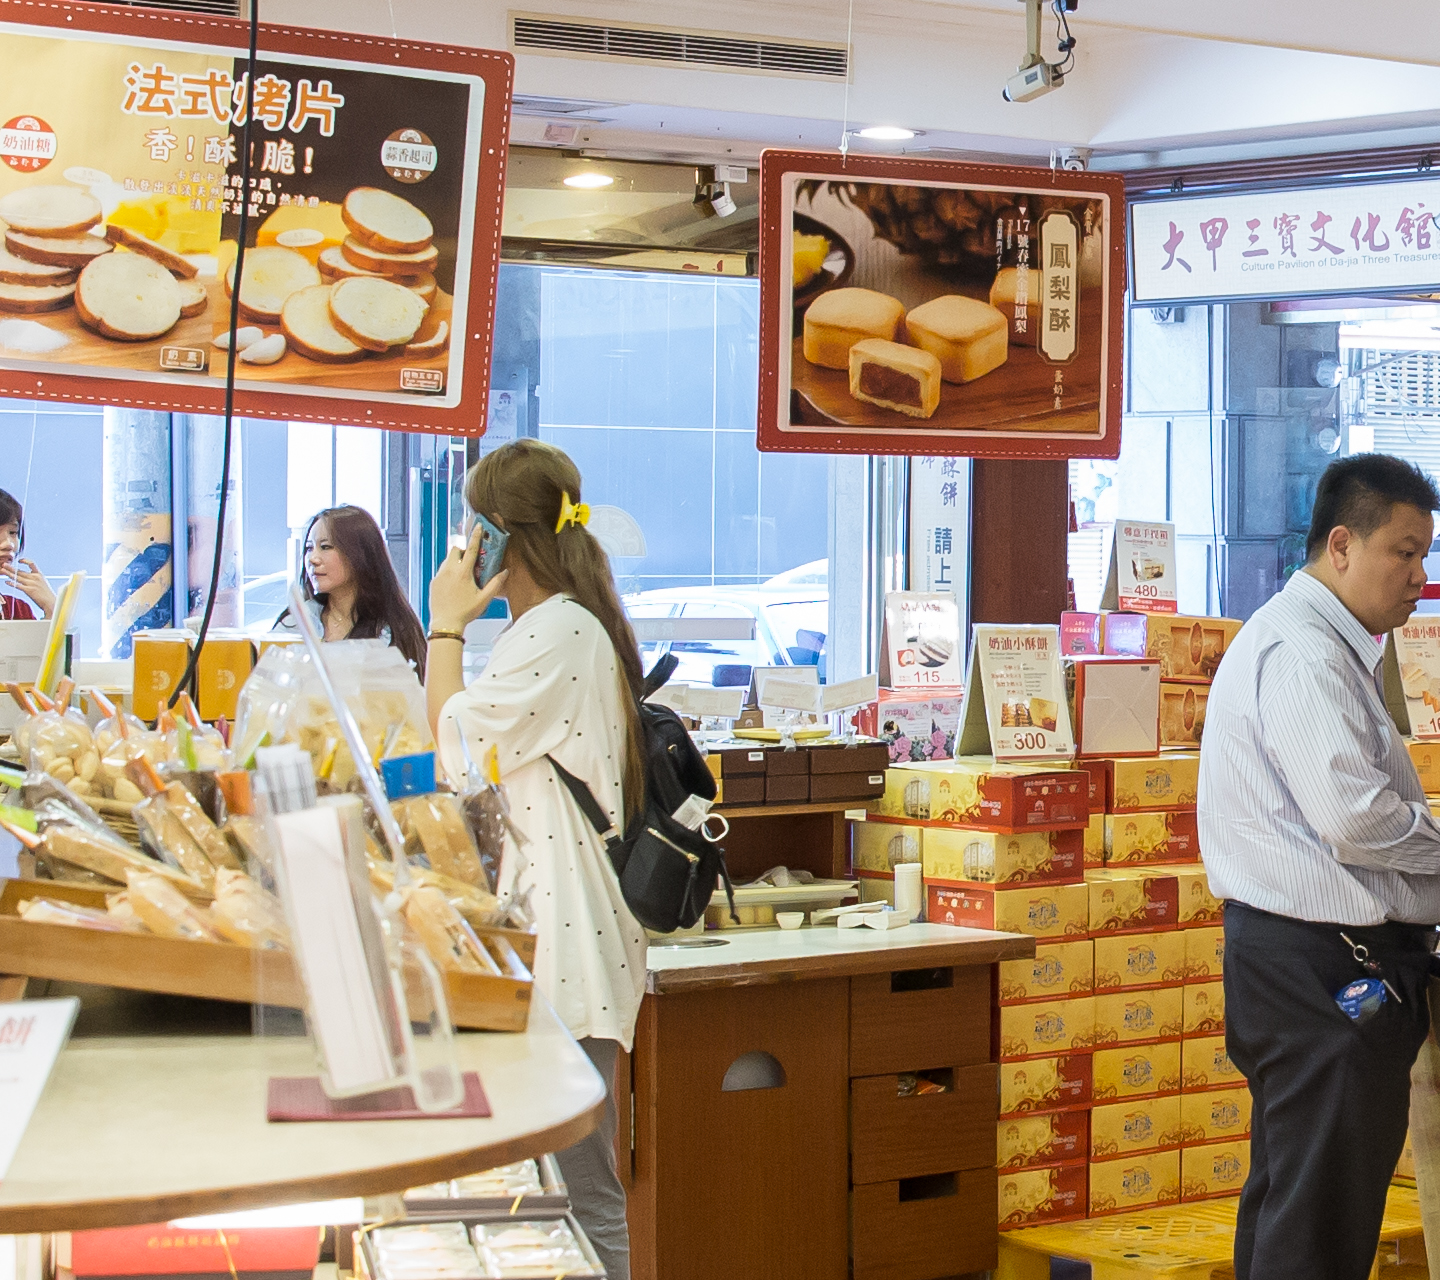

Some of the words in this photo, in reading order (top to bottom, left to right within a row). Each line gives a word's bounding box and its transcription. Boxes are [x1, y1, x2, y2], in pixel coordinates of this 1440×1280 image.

[122, 62, 345, 138] 法式烤片
[1160, 202, 1435, 274] 大甲三寶文化館
[1241, 260, 1275, 273] Culture
[1277, 258, 1315, 270] Pavilion
[1317, 257, 1328, 268] of
[1330, 255, 1359, 268] Da-jia
[1362, 254, 1391, 266] Three
[1049, 243, 1071, 333] 鳳梨酥
[1134, 584, 1158, 597] 480
[914, 670, 940, 683] 115
[1014, 732, 1046, 750] 300
